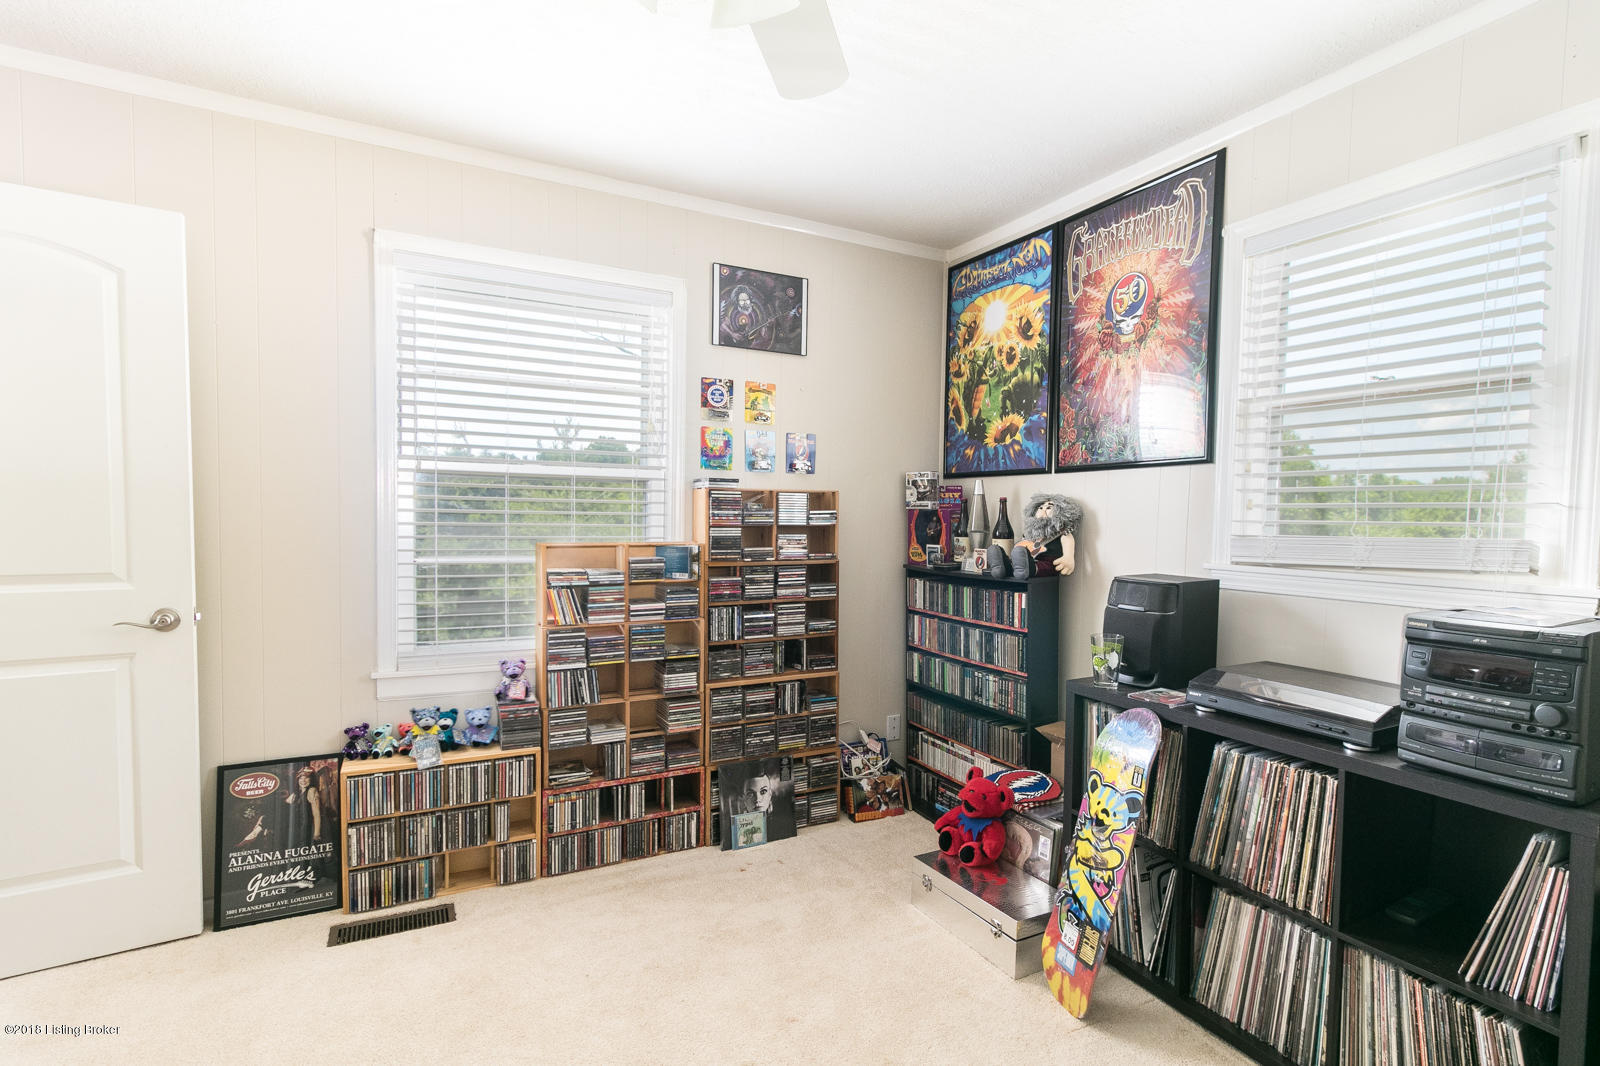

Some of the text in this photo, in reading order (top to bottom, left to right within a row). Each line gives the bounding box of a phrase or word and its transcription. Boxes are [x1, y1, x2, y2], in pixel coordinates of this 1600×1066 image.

[1067, 177, 1208, 305] GRATEFUL DEAD
[1114, 278, 1146, 314] 50
[234, 776, 276, 791] Falls City
[228, 842, 334, 868] ALANNA FUGATE
[229, 848, 260, 858] PRESENTS
[228, 866, 242, 874] AND
[243, 862, 269, 873] FRIENDS
[269, 858, 290, 867] EVERY
[246, 865, 317, 903] Gerstle's
[260, 888, 287, 898] PLACE
[238, 902, 276, 914] FRANKFORT
